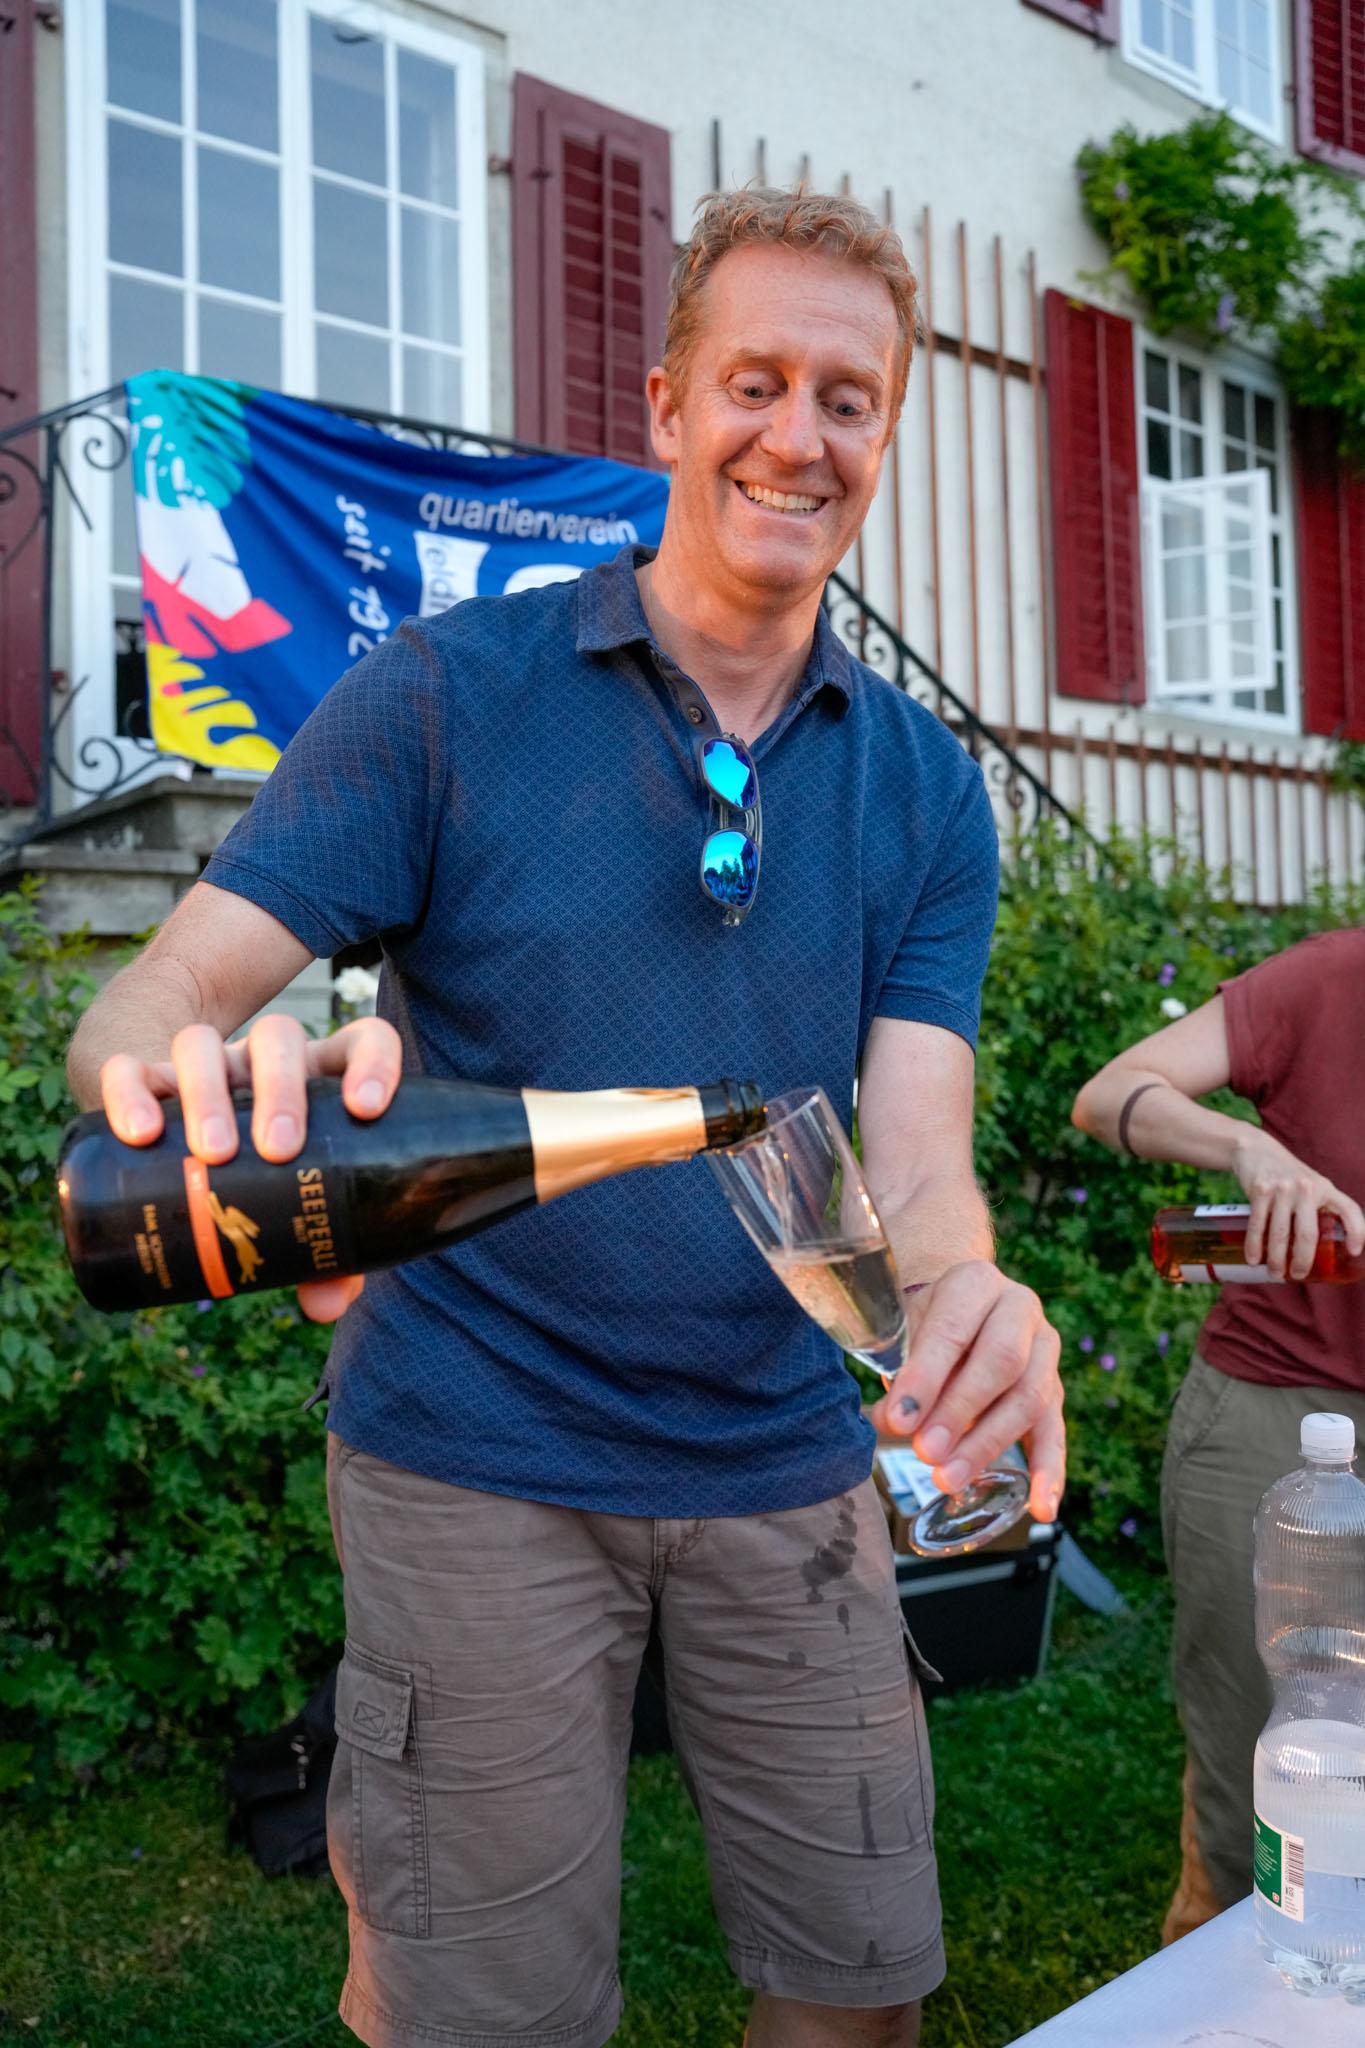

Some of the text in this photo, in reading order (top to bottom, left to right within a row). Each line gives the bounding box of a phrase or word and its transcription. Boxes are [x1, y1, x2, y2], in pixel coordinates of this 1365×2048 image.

[418, 491, 639, 546] quartierverein
[335, 494, 392, 657] seit 192
